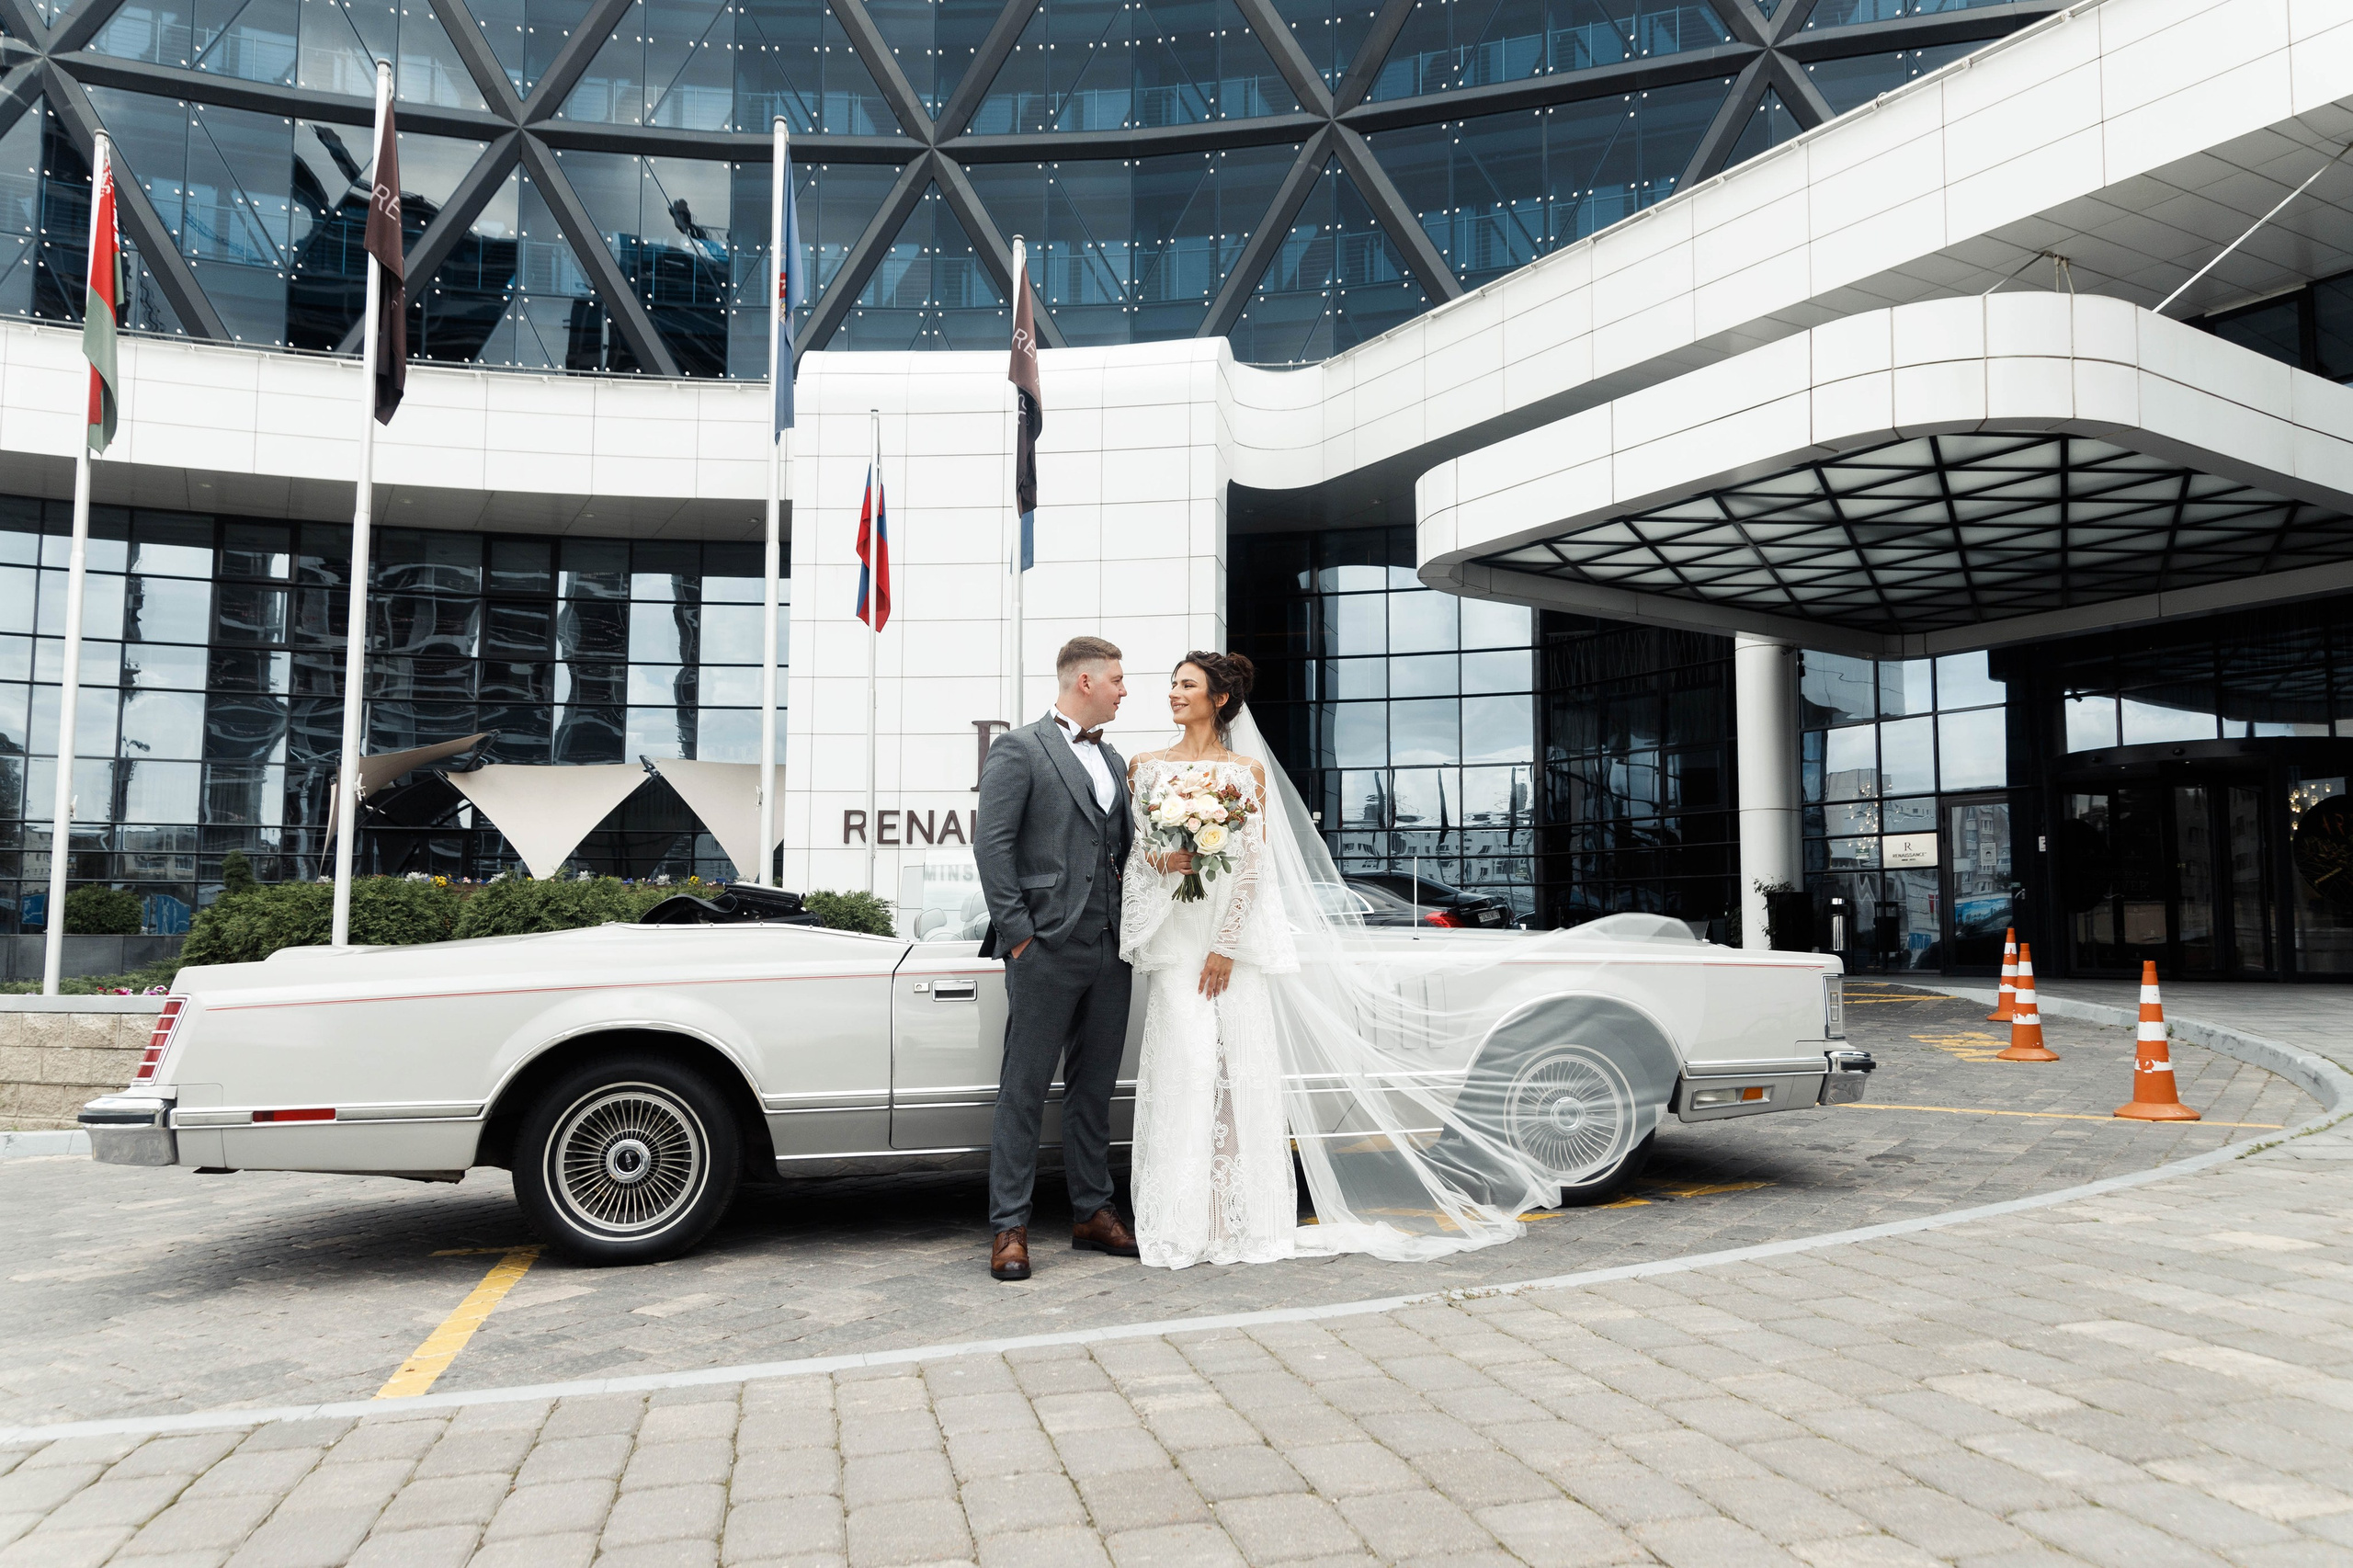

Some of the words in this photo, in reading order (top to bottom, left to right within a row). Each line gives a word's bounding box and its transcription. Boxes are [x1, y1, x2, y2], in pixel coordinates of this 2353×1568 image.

[370, 183, 402, 222] RE
[1012, 328, 1037, 358] RE
[843, 810, 977, 845] RENAI
[1904, 842, 1913, 851] R
[924, 864, 981, 881] MINS
